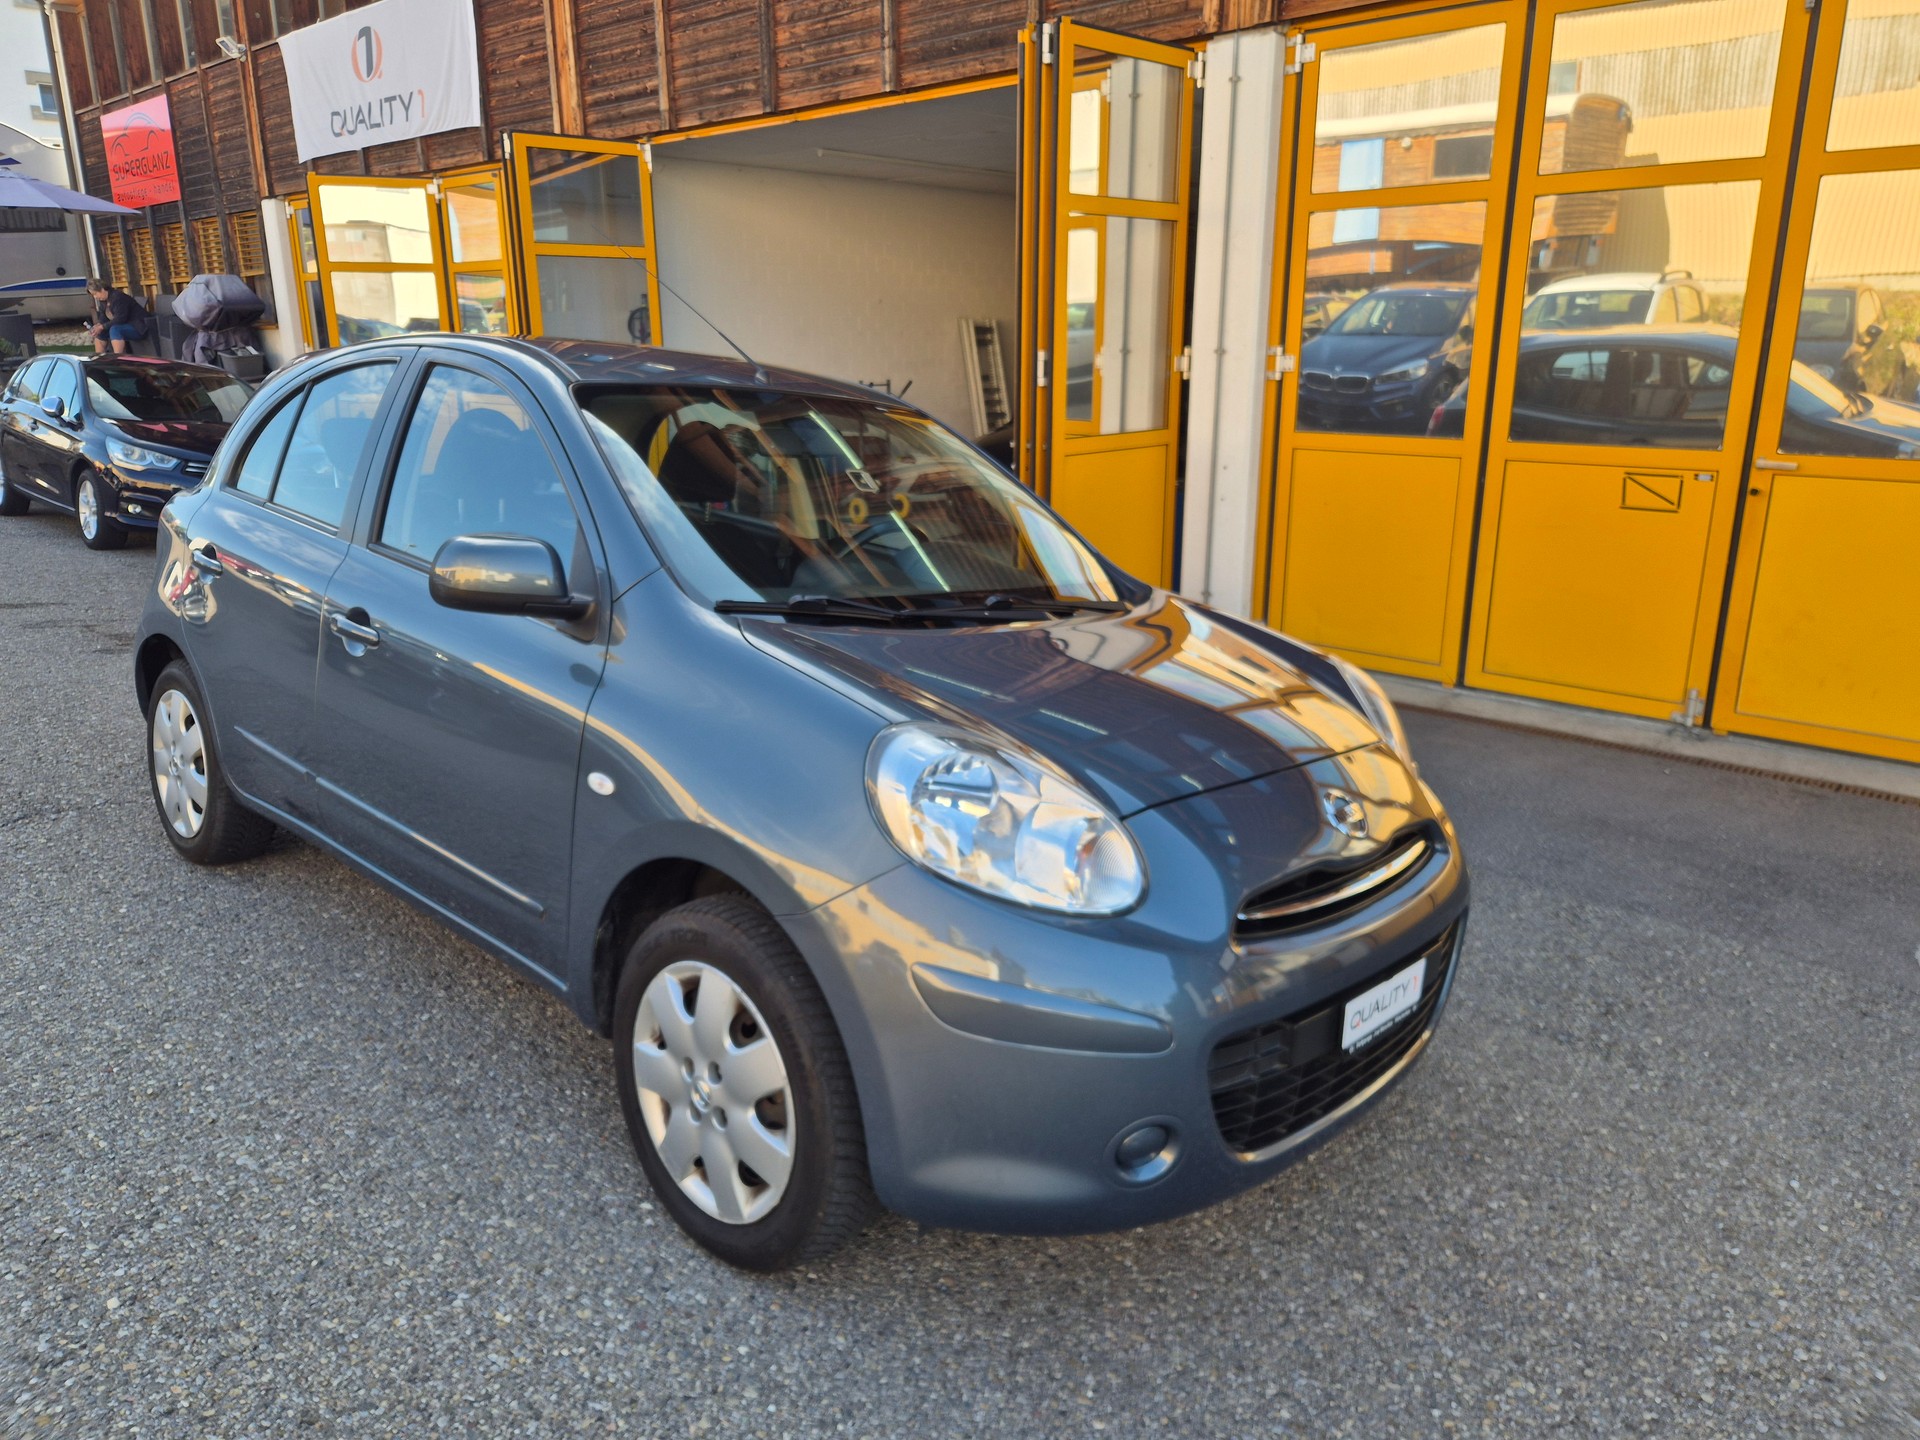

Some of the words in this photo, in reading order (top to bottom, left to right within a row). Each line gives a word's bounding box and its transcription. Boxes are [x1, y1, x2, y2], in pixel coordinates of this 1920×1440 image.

[330, 90, 414, 138] QUALITY
[112, 151, 171, 182] SUPERGLANZ
[1350, 978, 1411, 1031] QUALITY
